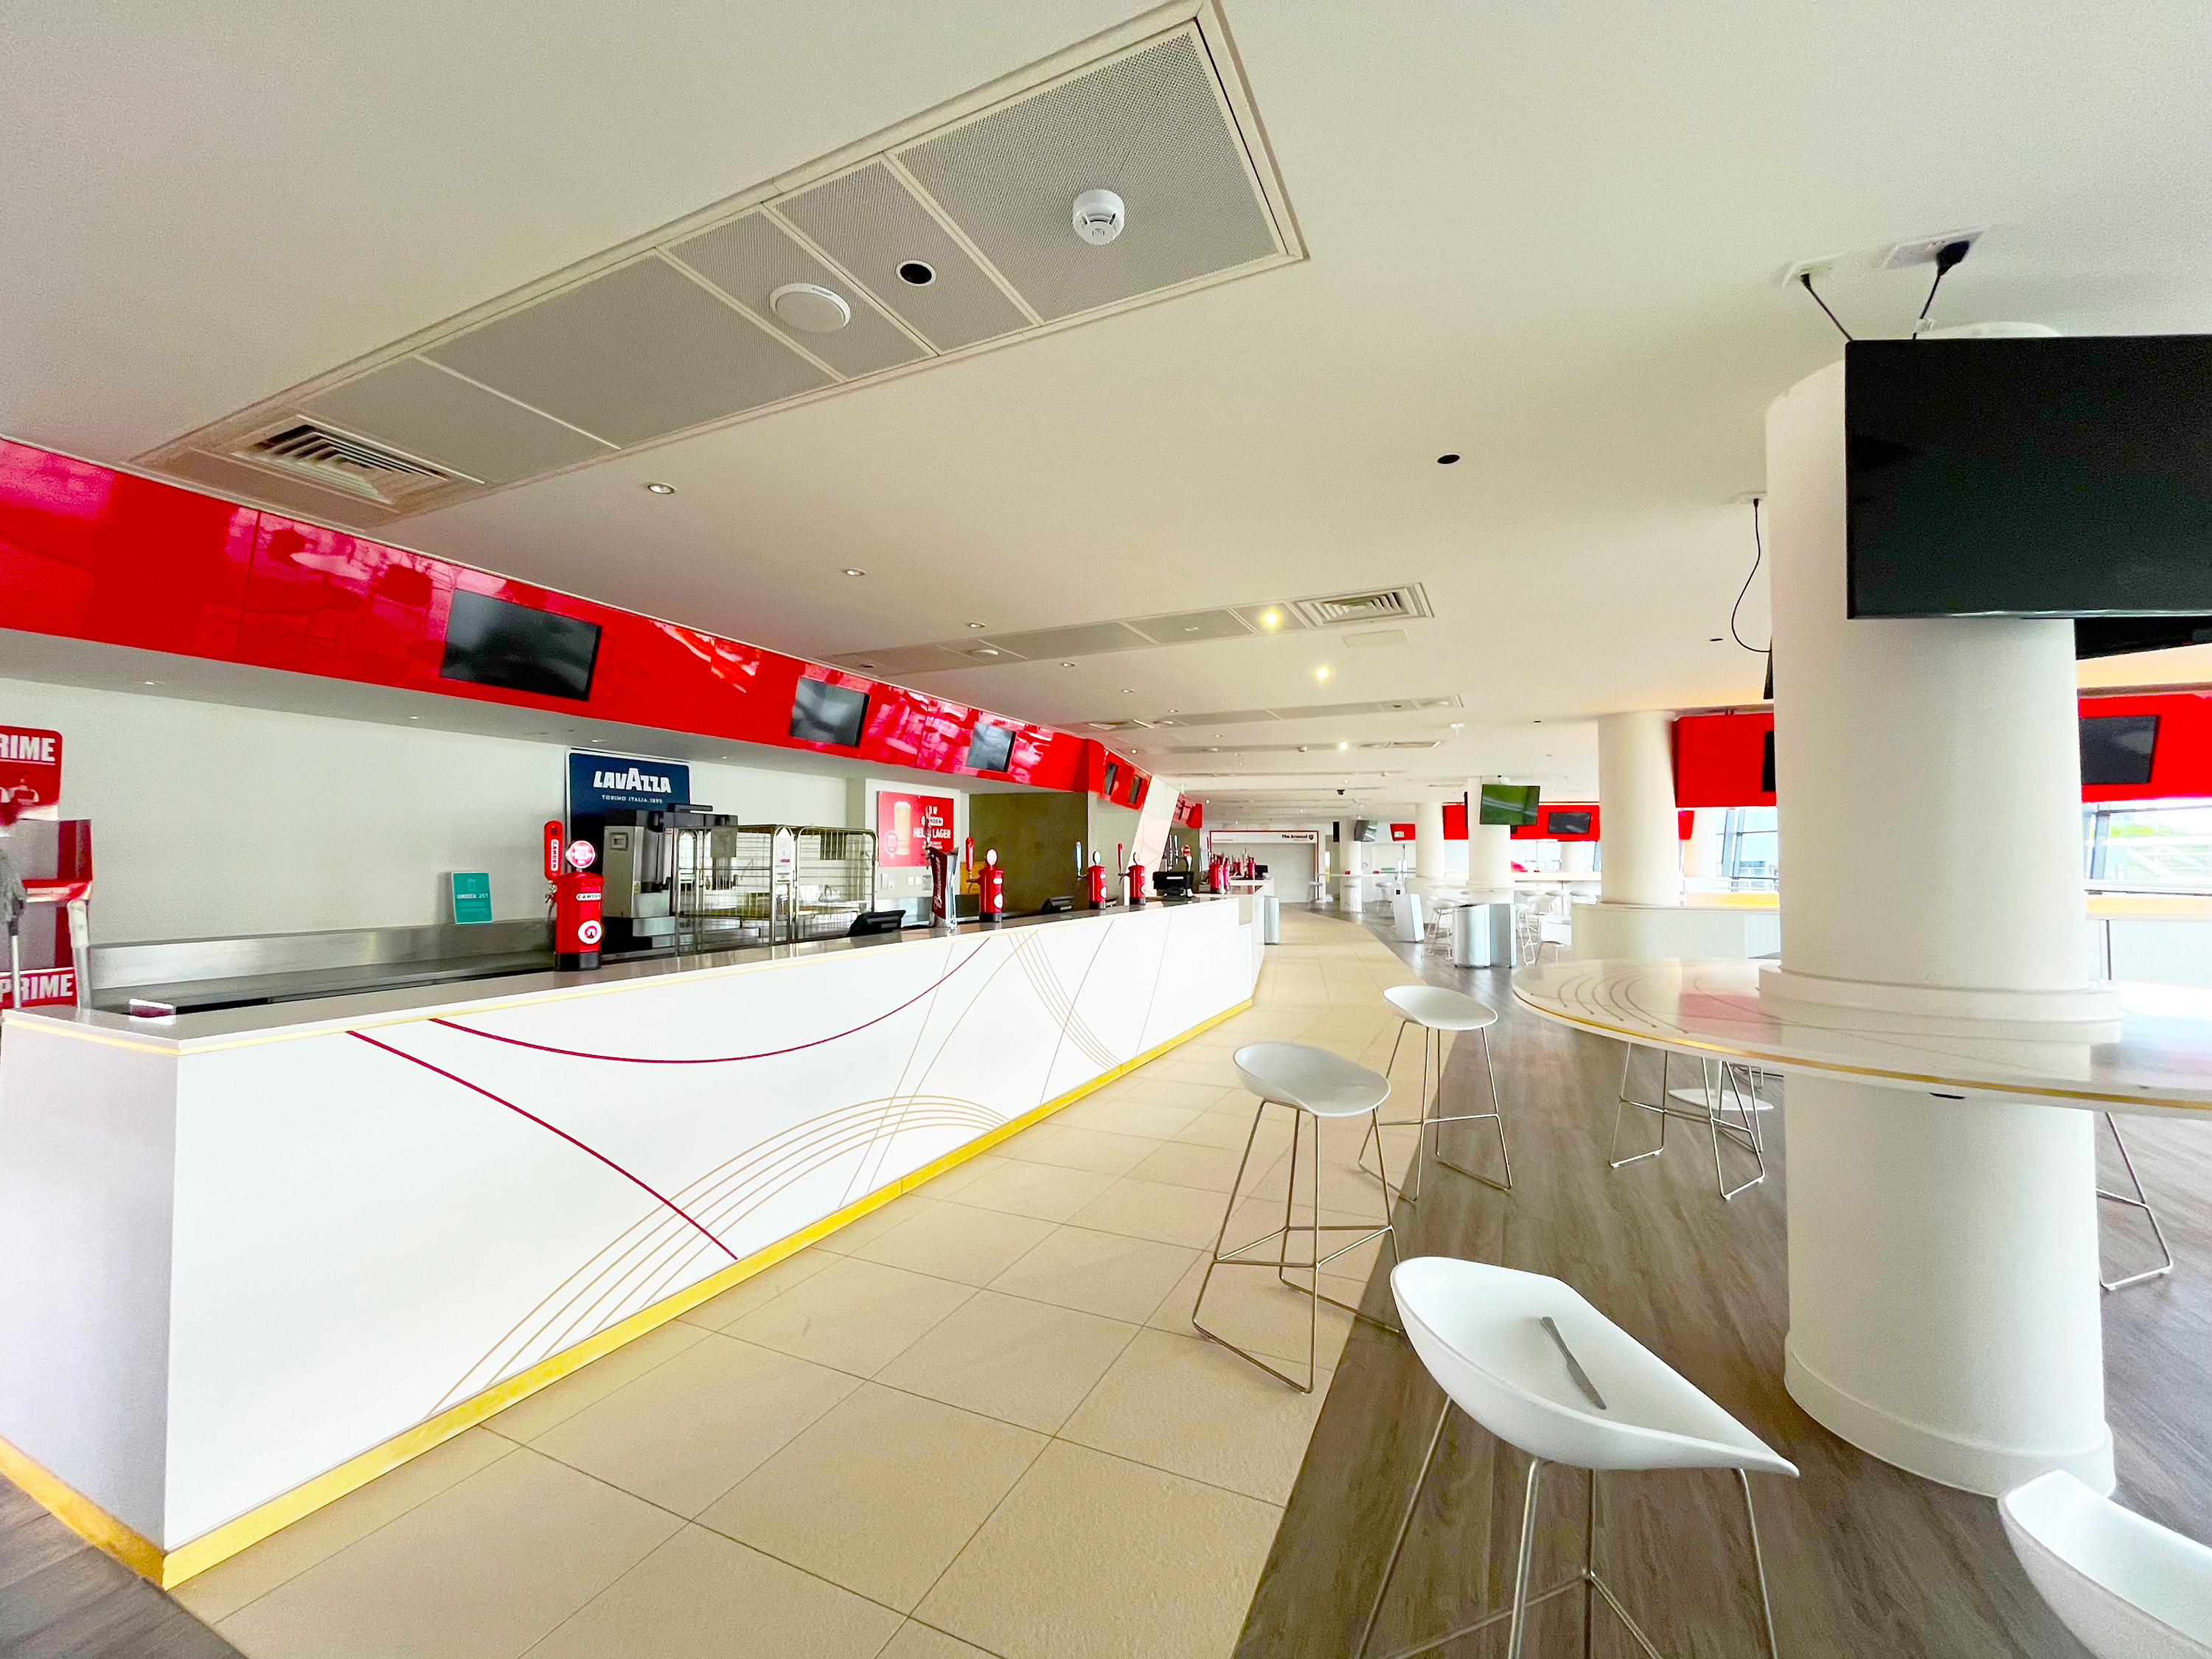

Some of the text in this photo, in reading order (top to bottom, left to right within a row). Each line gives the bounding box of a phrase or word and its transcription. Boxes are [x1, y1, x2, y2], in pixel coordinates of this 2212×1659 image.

[593, 767, 672, 793] LAVAZZA
[932, 828, 951, 839] LAGER
[0, 973, 74, 1003] PRIME
